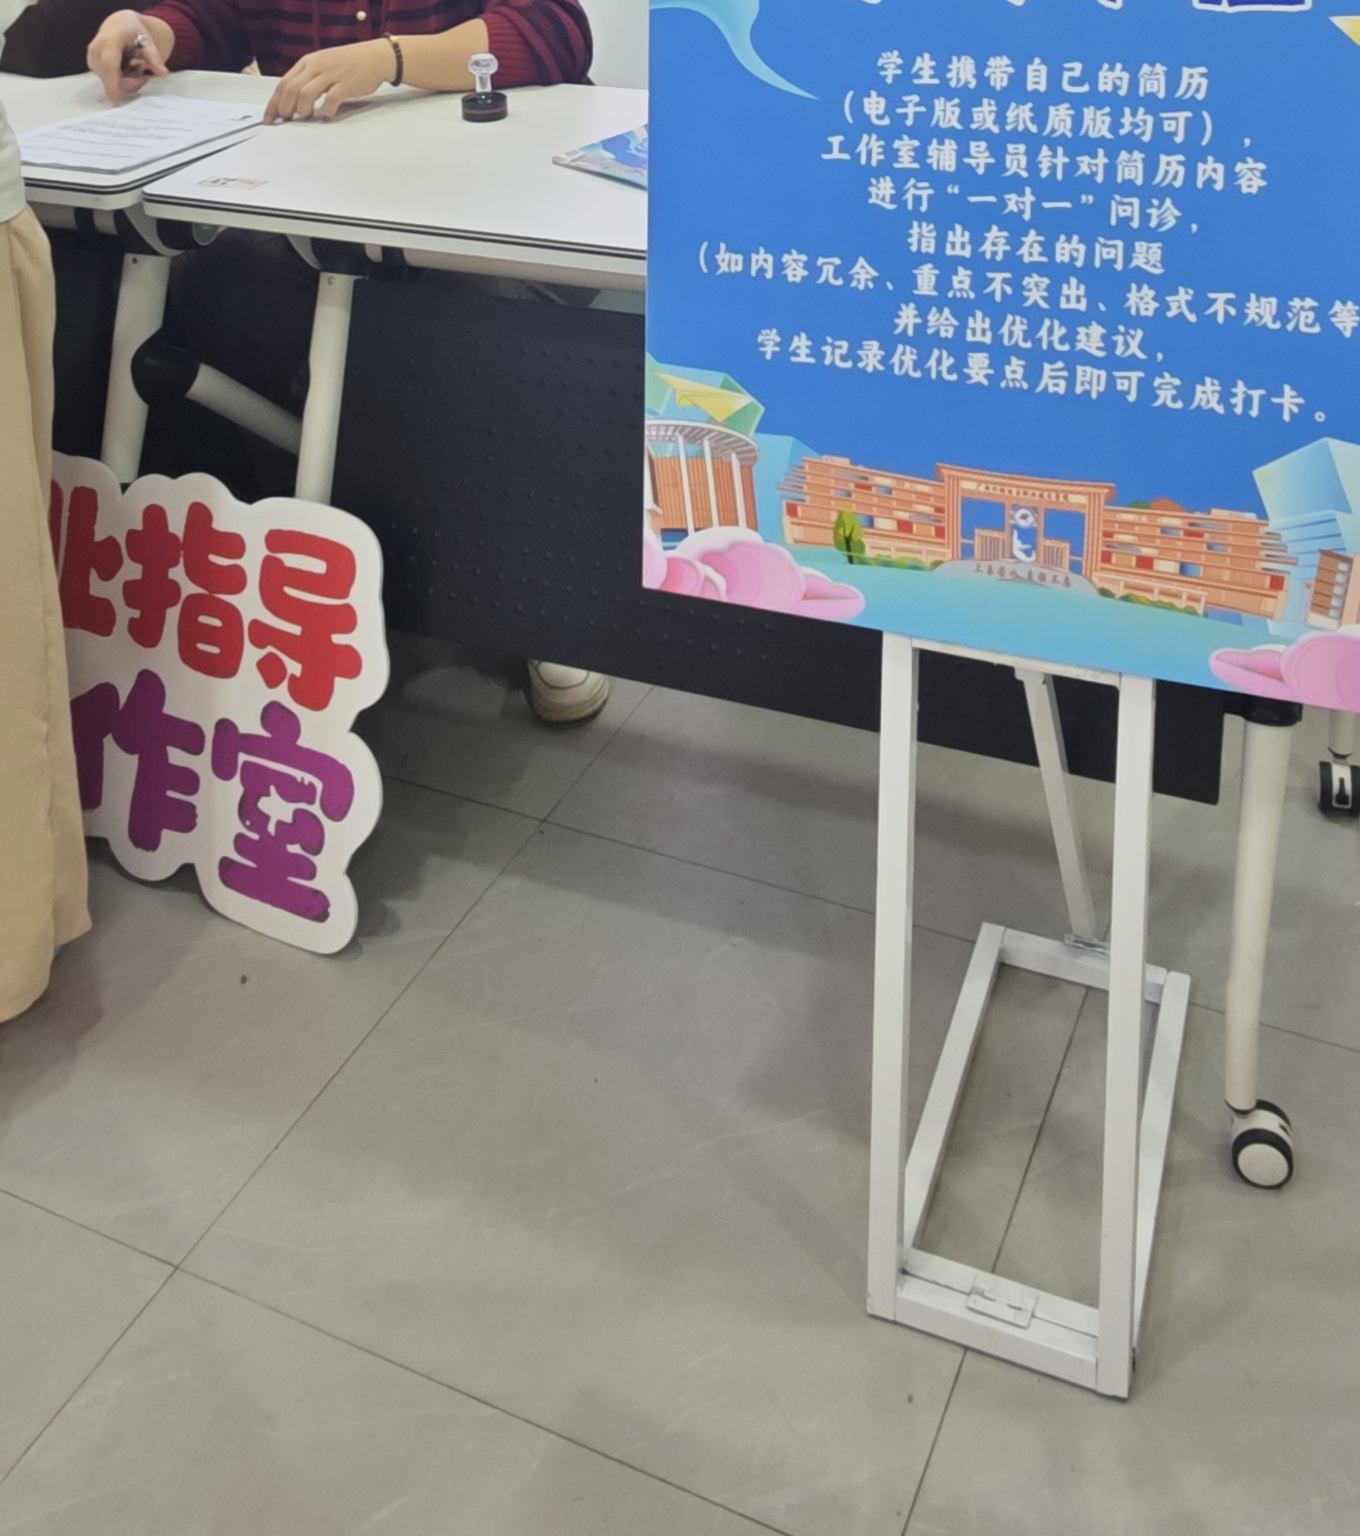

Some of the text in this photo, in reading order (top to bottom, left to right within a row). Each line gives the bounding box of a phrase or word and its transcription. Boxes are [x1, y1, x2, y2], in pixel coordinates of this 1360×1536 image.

[876, 50, 1209, 101] 学生携带自己的简历
[820, 132, 1269, 195] 工作室辅导员针对简历内容
[907, 220, 1166, 275] 指出存在的问题
[757, 327, 1327, 424] 学生记录优化要点后即可完成打卡。
